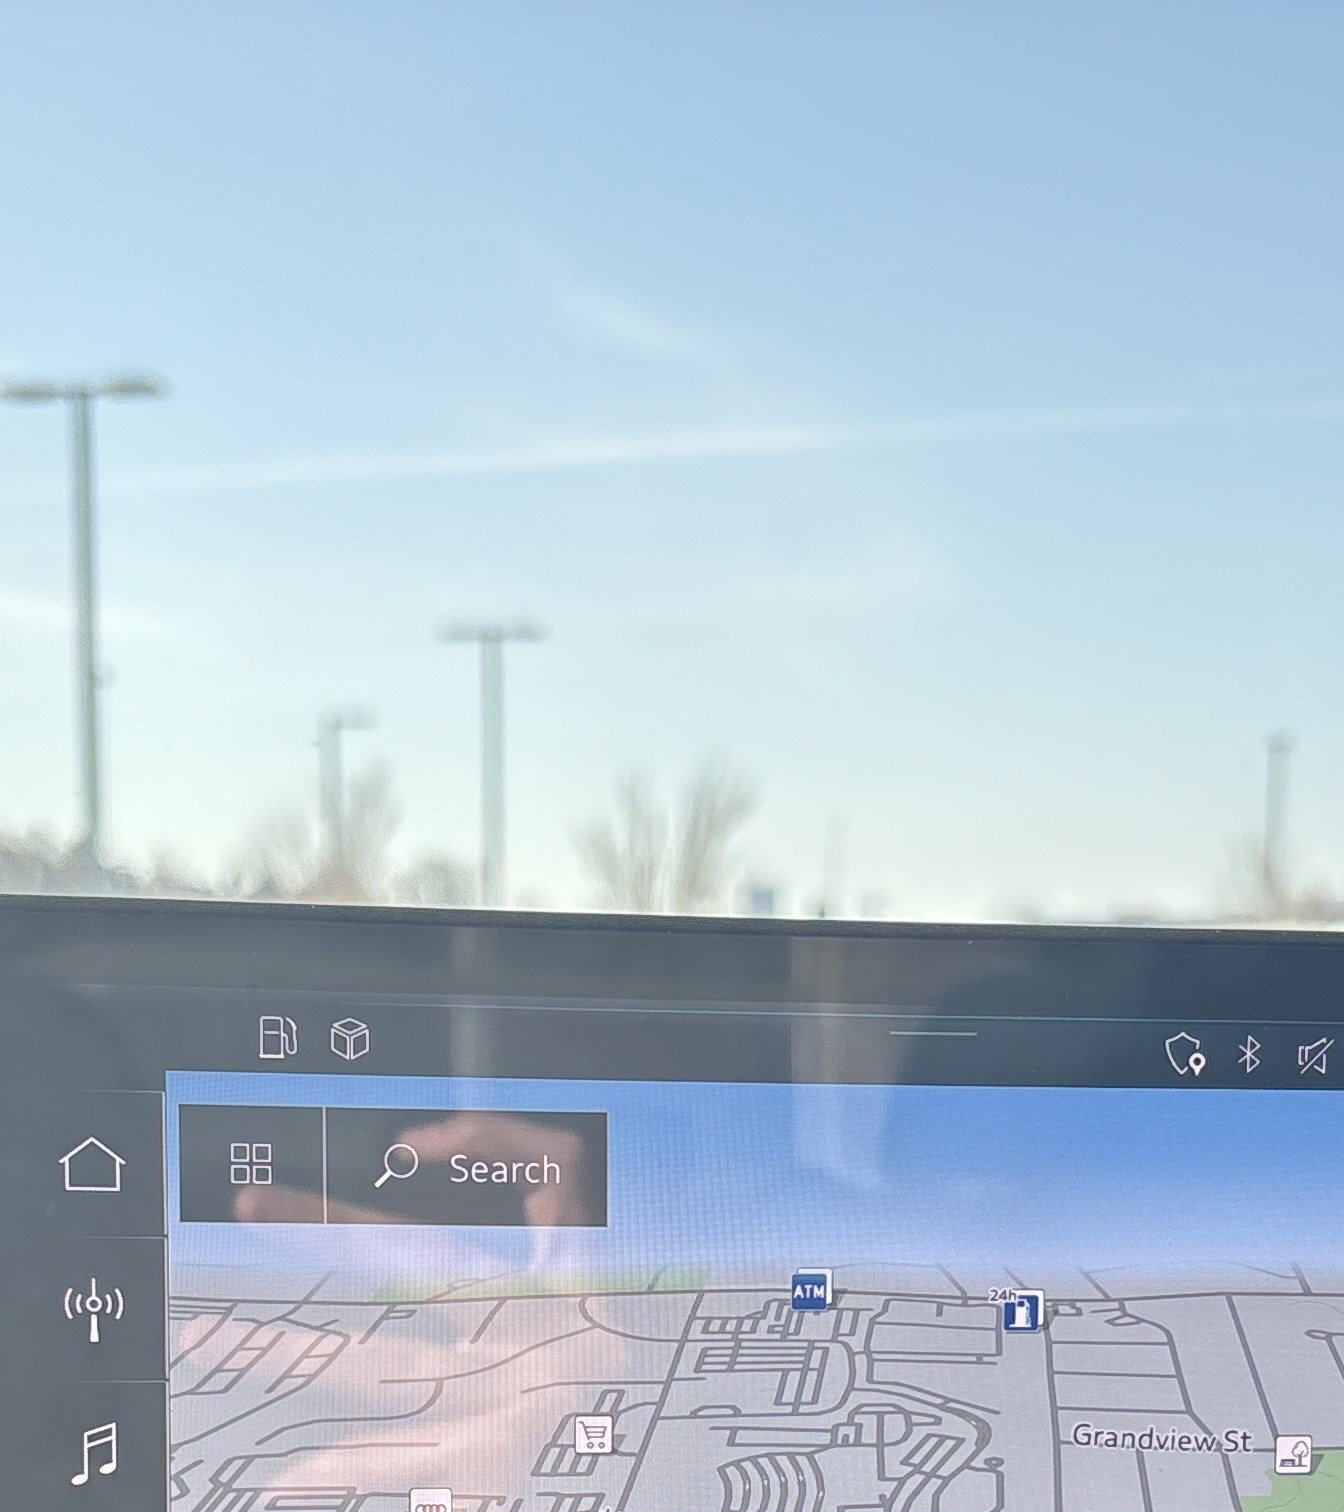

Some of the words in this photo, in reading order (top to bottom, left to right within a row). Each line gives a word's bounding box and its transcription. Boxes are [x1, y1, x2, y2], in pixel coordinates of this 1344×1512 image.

[449, 1154, 561, 1185] Search
[793, 1284, 825, 1299] ATM
[989, 1289, 1018, 1302] 24h
[1073, 1422, 1217, 1452] Grandview
[1223, 1429, 1252, 1453] St
